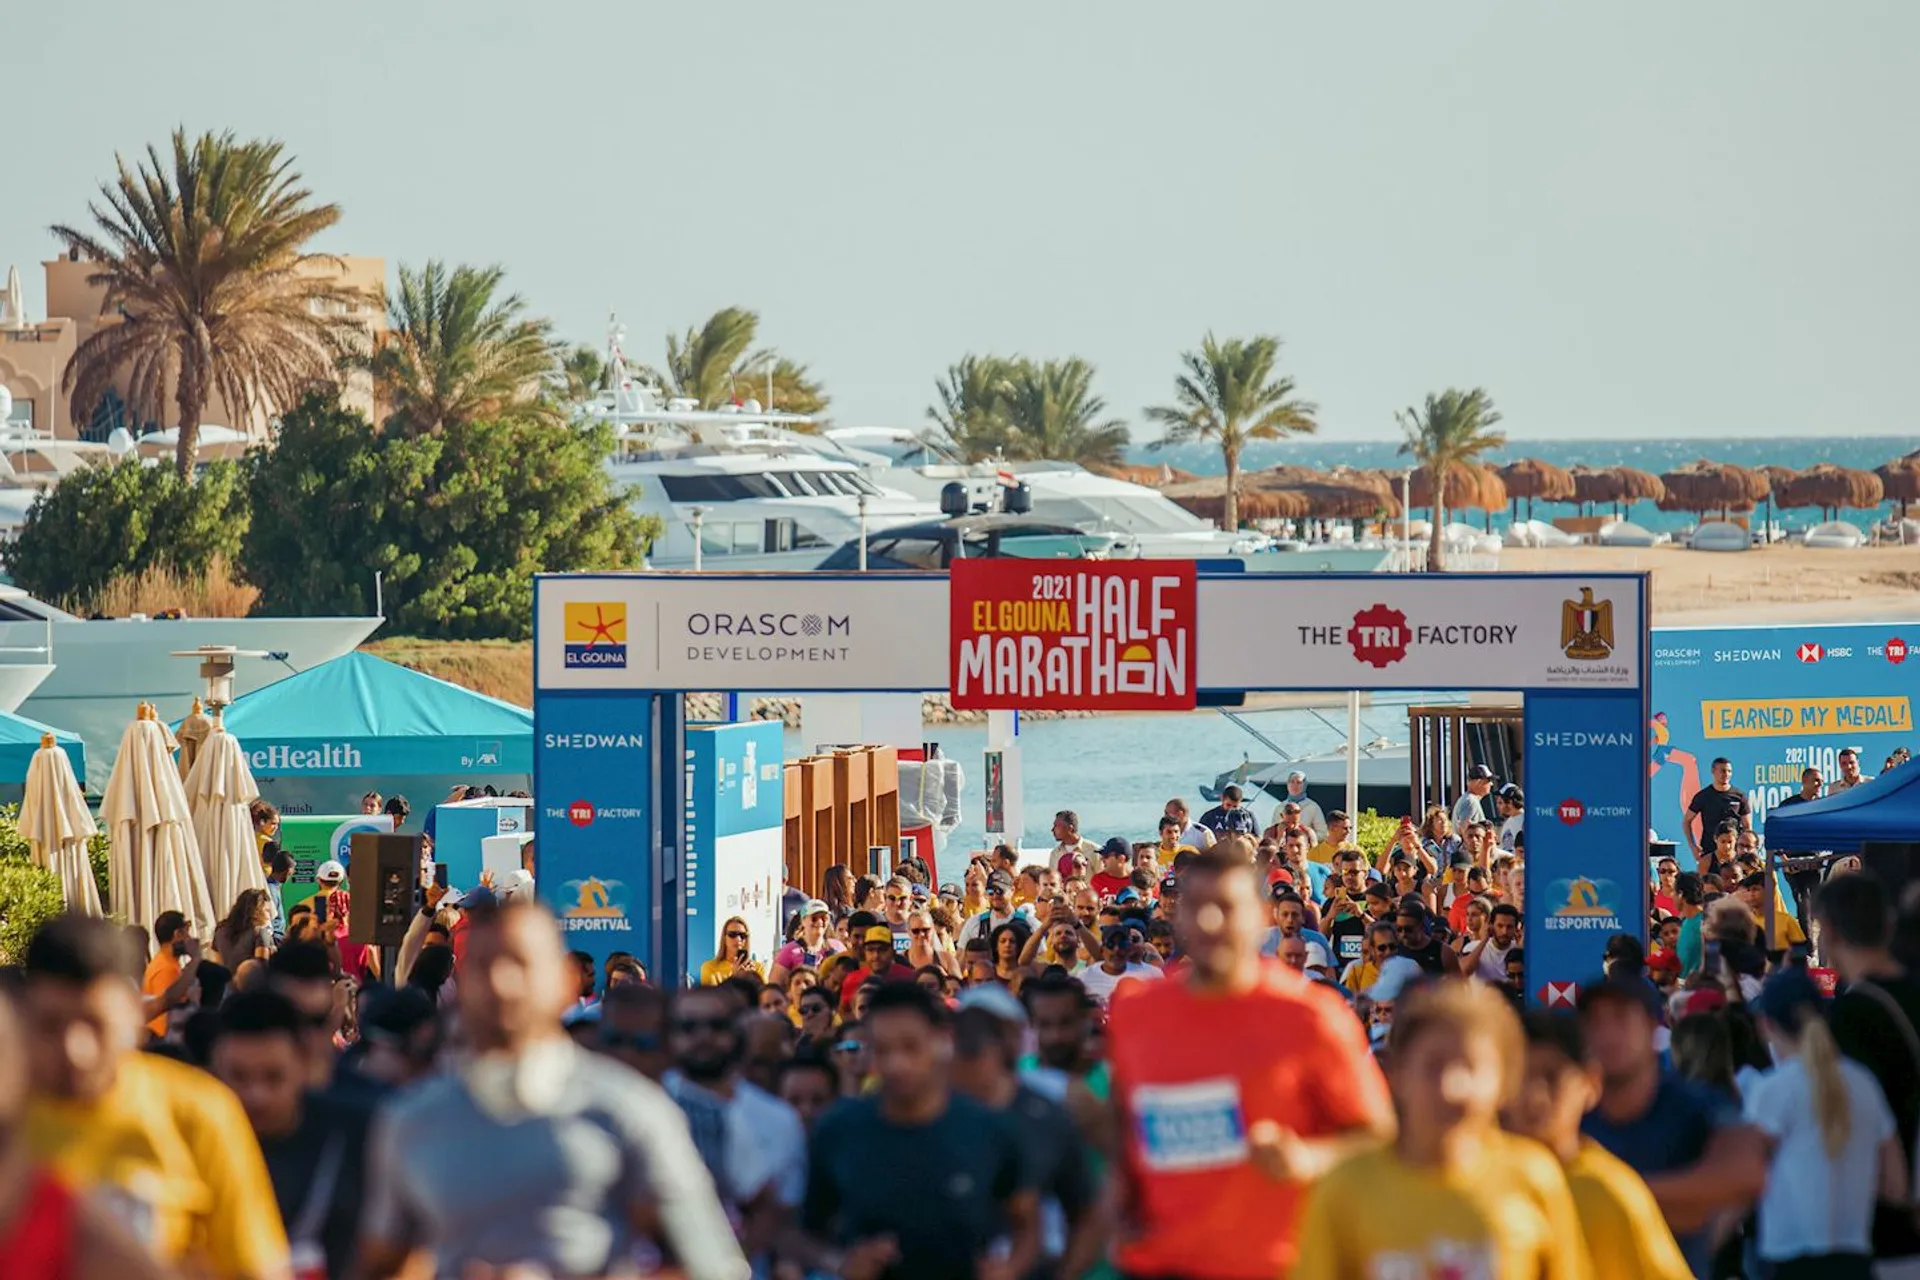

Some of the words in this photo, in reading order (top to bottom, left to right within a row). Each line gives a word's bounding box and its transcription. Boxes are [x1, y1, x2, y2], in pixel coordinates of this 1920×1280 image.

[1032, 575, 1072, 600] 2021
[1076, 572, 1181, 644] HALF
[973, 601, 997, 632] EL
[1000, 601, 1071, 632] GOUNA
[688, 613, 850, 636] ORASCOM
[1298, 626, 1342, 645] THE
[1358, 626, 1400, 648] TRI
[1417, 625, 1518, 645] FACTORY
[566, 653, 580, 663] EL
[581, 653, 625, 663] GOUNA
[688, 647, 850, 661] DEVELOPMENT
[1714, 649, 1781, 662] SHEDWAN
[1827, 647, 1853, 657] HSBC
[1867, 646, 1882, 656] THE
[1888, 646, 1904, 656] TRI
[1710, 709, 1715, 730] I
[1721, 706, 1794, 730] EARNED
[1801, 706, 1829, 728] MY
[1836, 704, 1906, 727] MEDAL!
[545, 734, 643, 748] SHEDWAN
[1534, 732, 1633, 747] SHEDWAN
[461, 756, 474, 768] By
[1785, 748, 1807, 764] 2021
[1755, 765, 1768, 785] EL
[546, 808, 566, 818] THE
[572, 808, 592, 820] TRI
[597, 808, 642, 818] FACTORY
[1536, 807, 1554, 817] THE
[1561, 807, 1581, 817] TRI
[1587, 807, 1632, 817] FACTORY
[569, 918, 632, 931] SPORTVAL
[1558, 917, 1623, 930] SPORTVAL
